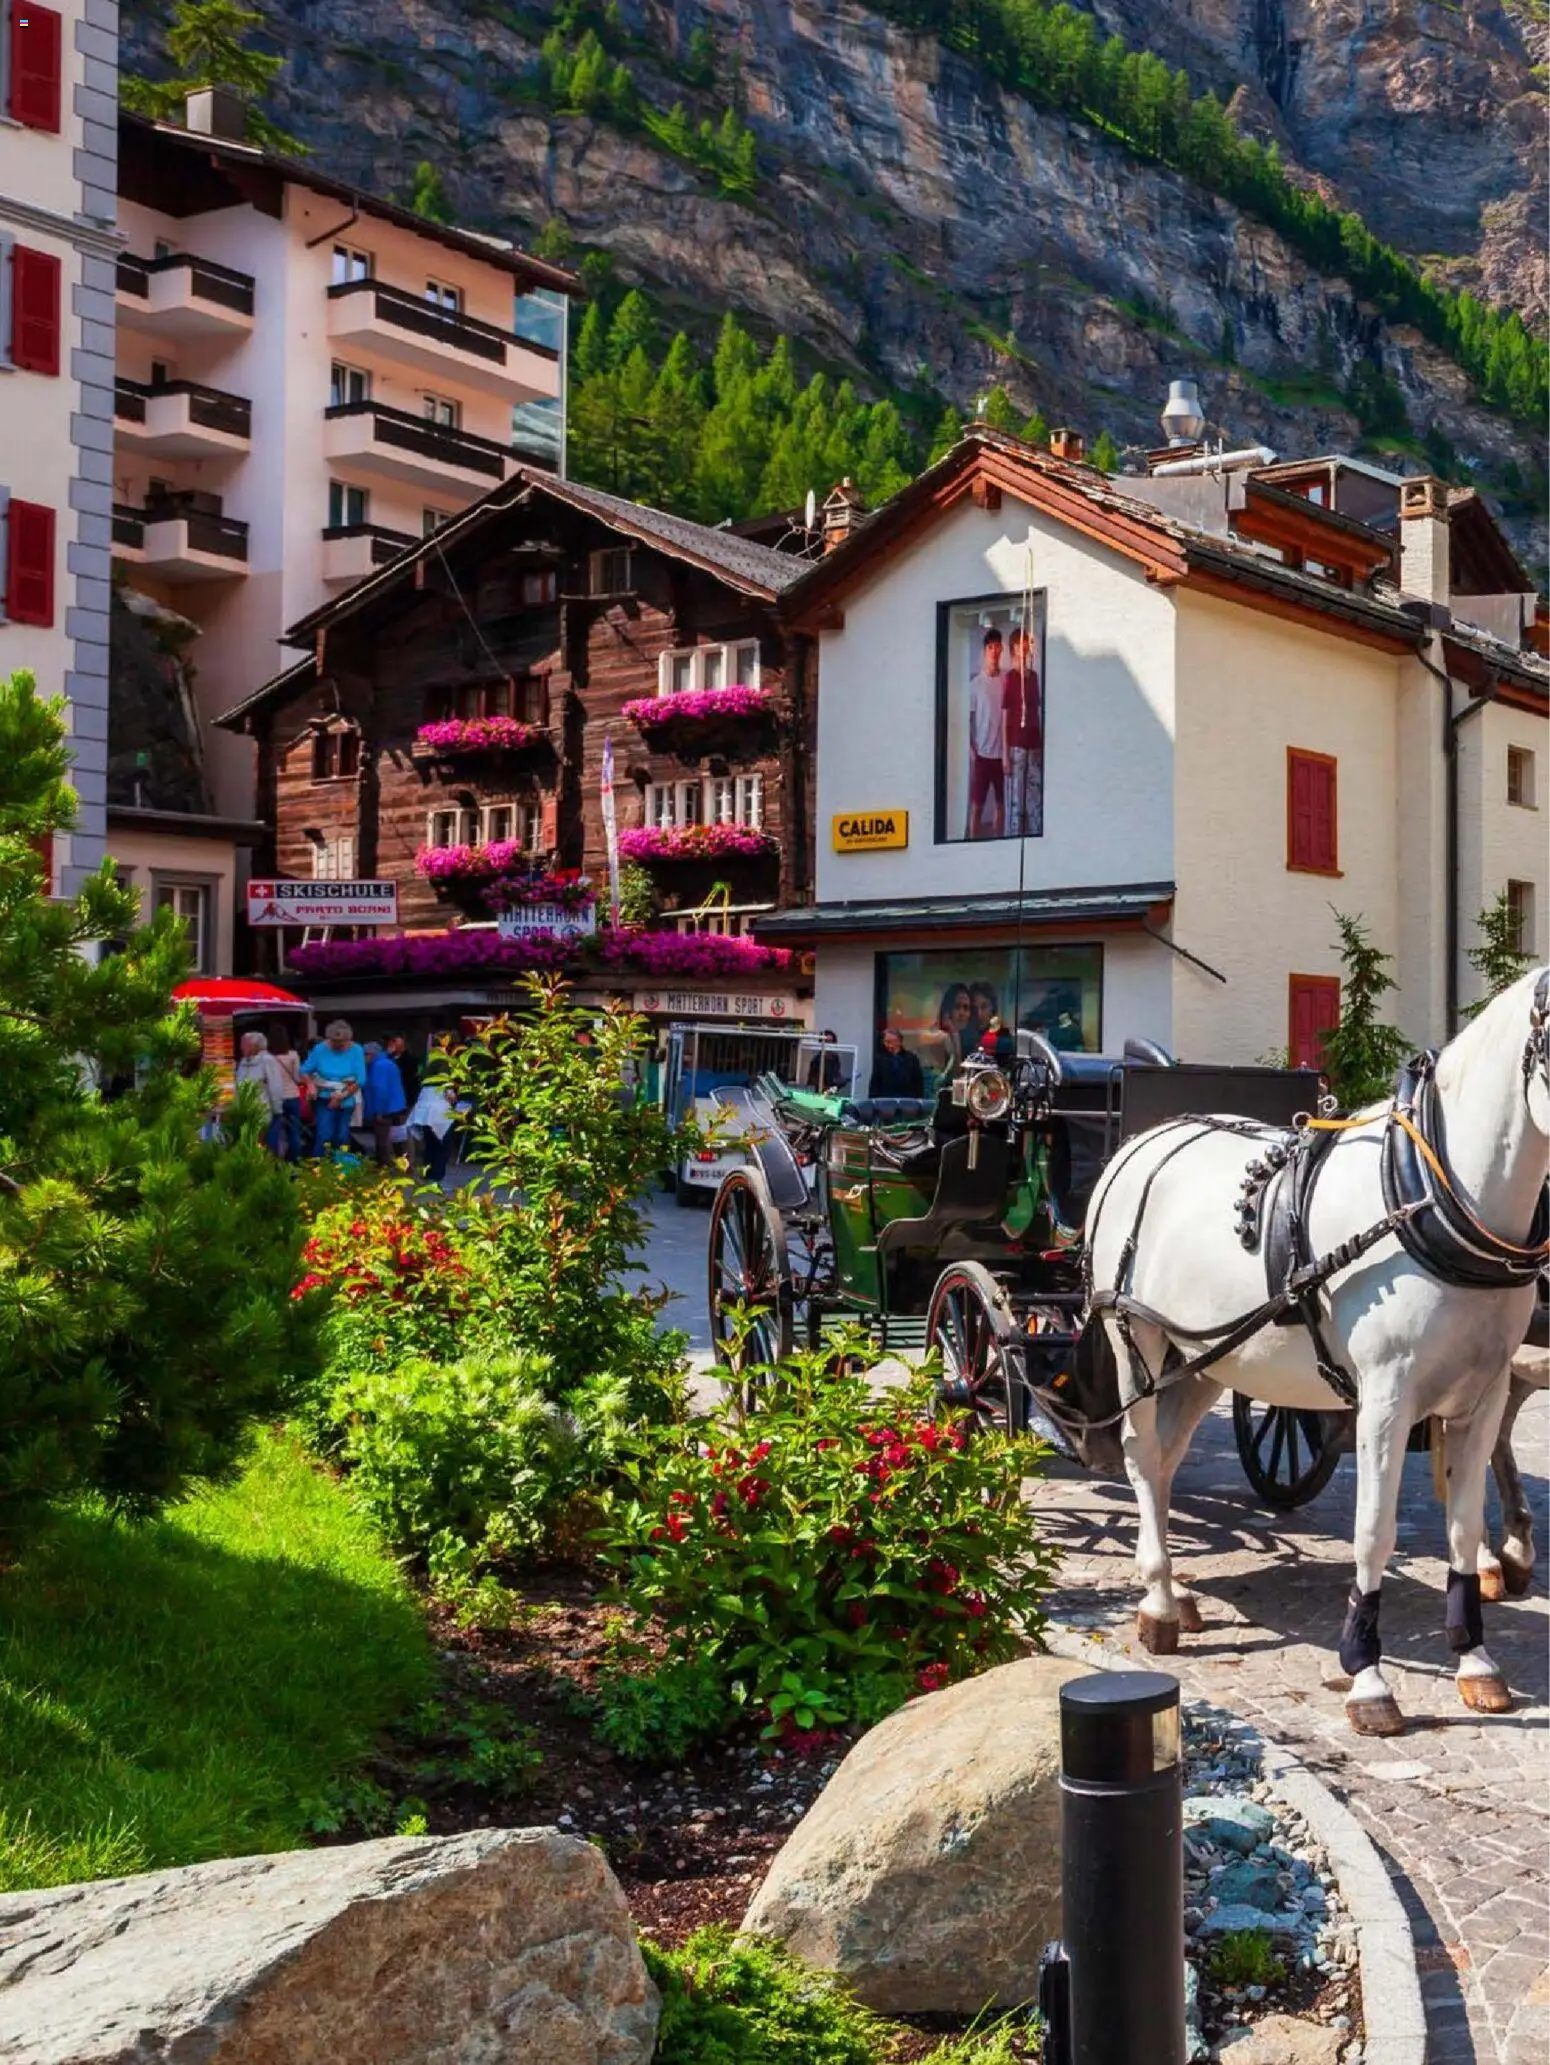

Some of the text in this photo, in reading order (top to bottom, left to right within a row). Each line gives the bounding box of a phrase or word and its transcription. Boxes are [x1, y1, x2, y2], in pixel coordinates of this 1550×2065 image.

[839, 818, 896, 837] CALIDA
[280, 884, 391, 897] SKISCHULE
[667, 991, 763, 1014] MATTERHORN SPORT
